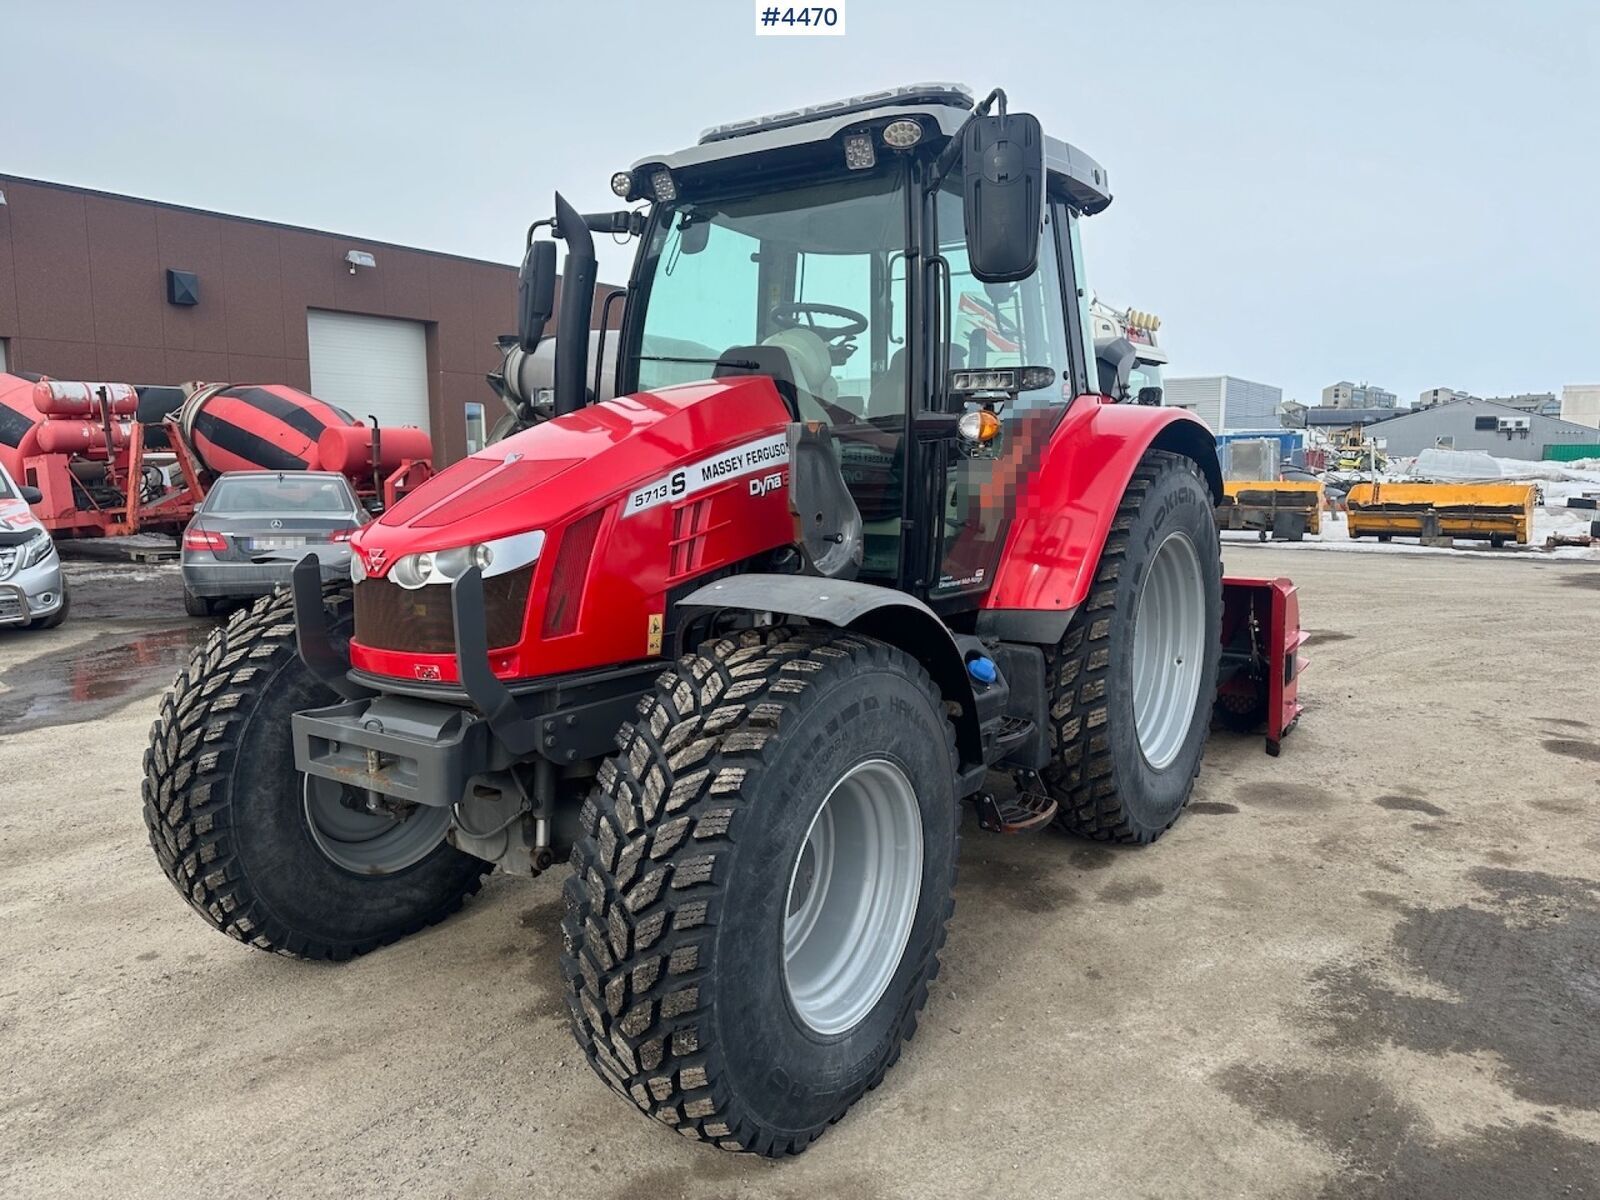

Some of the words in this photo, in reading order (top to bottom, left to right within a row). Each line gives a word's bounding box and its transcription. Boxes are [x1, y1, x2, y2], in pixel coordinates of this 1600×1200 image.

[634, 485, 667, 507] 5713
[671, 472, 686, 496] S
[701, 454, 743, 481] MASSEY
